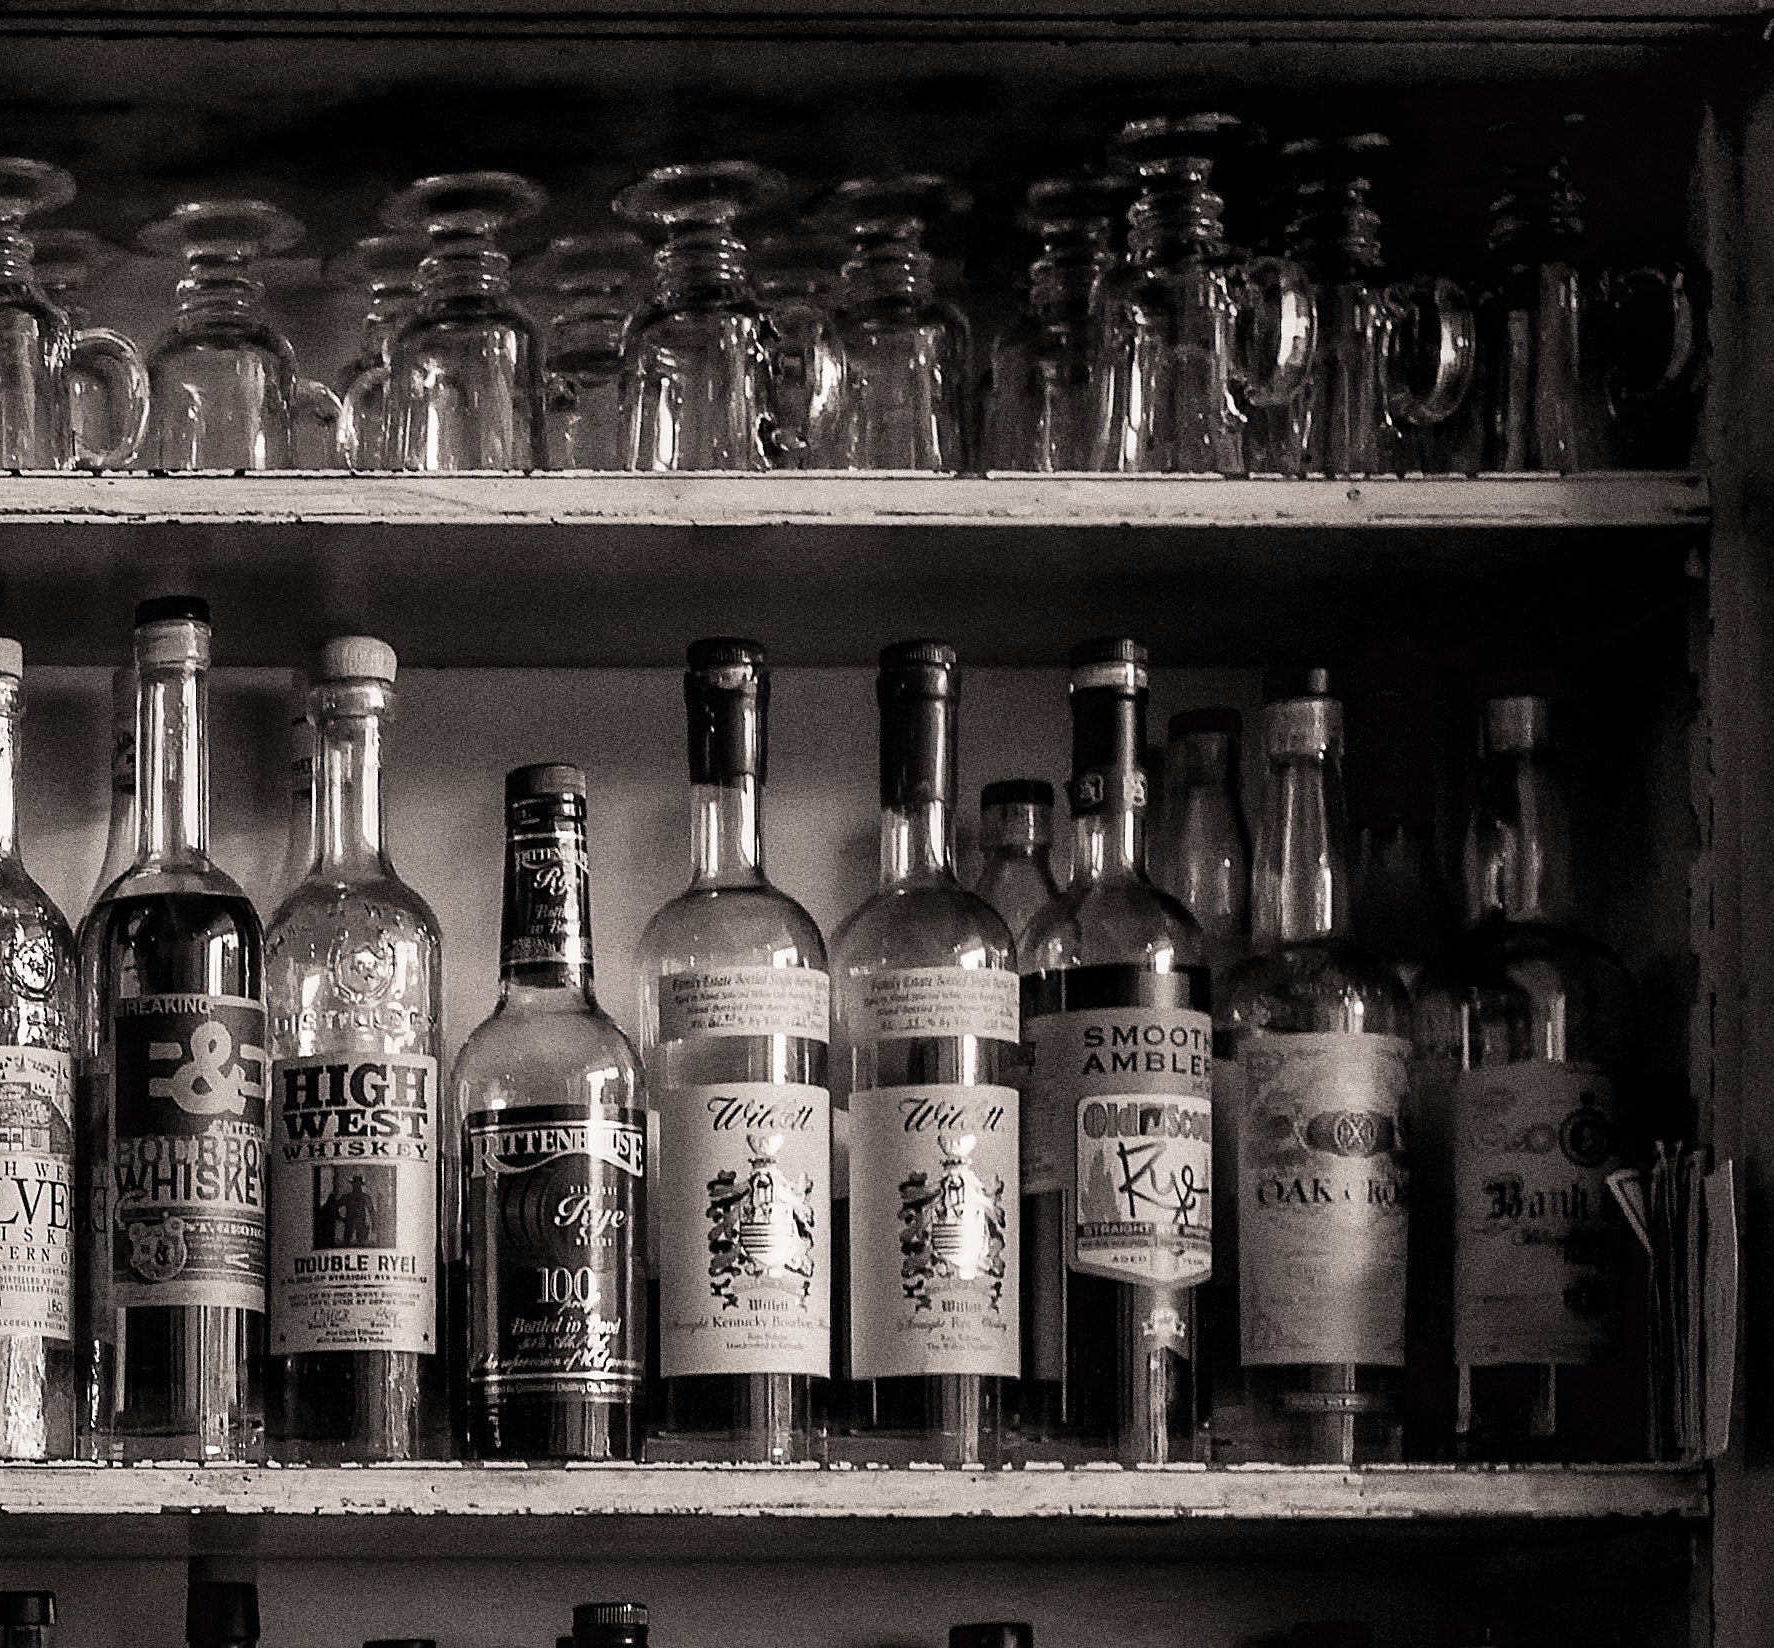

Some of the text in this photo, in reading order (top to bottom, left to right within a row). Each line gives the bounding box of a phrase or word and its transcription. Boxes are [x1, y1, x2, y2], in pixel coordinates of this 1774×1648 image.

[283, 1063, 428, 1109] HIGH
[283, 1109, 428, 1139] WEST
[1083, 1102, 1138, 1138] Old
[283, 1141, 428, 1160] WHISKEY
[35, 1162, 73, 1178] WES
[1117, 1141, 1210, 1226] Rye
[1258, 1178, 1333, 1204] OAK
[554, 1195, 625, 1235] Rye
[294, 1254, 369, 1274] DOUBLE
[537, 1267, 596, 1303] 100
